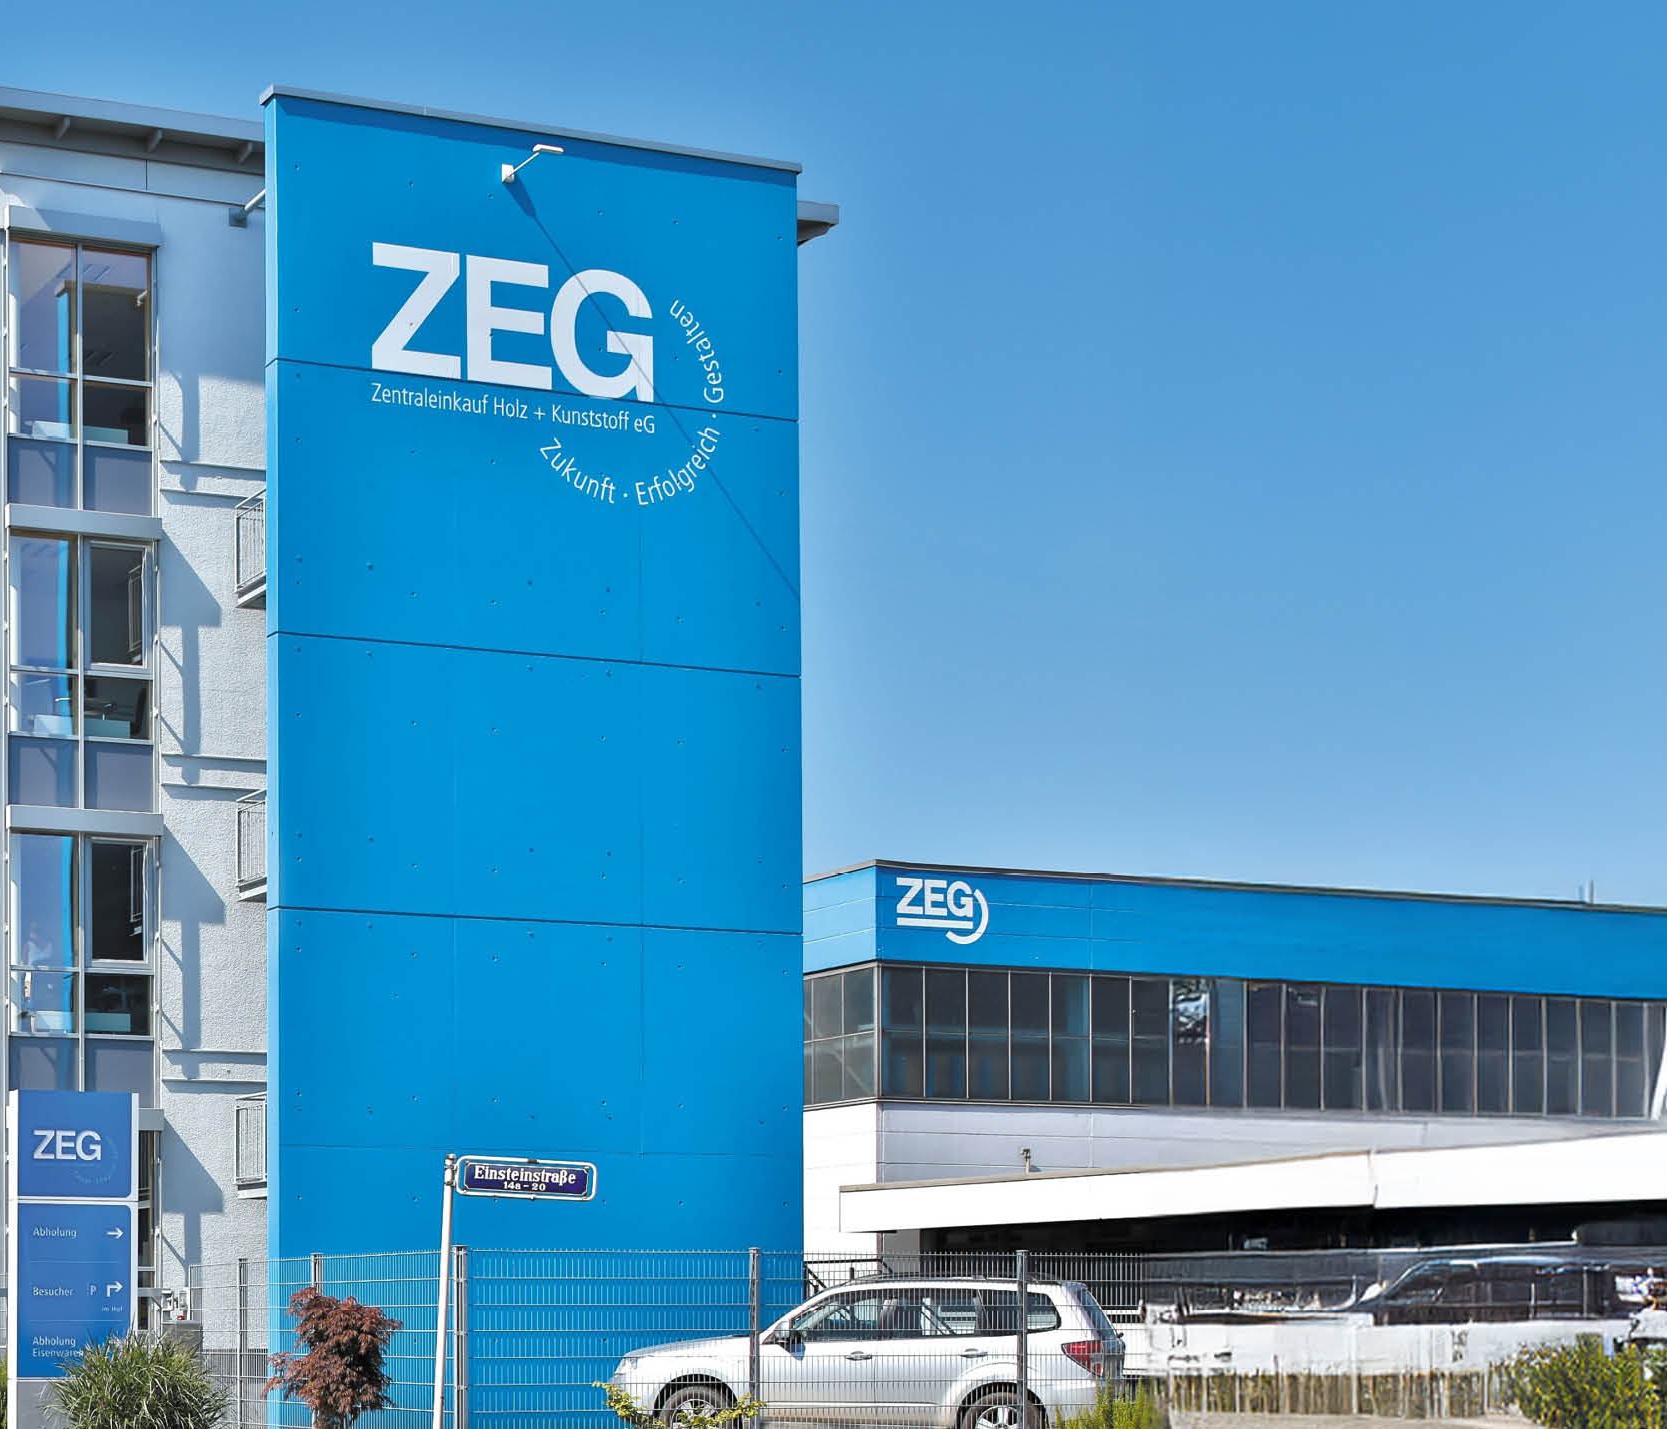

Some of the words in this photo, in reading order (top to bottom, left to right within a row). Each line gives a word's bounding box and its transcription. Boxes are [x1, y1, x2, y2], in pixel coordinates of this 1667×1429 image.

[371, 241, 655, 403] ZEG
[668, 299, 725, 404] Gestalten
[371, 382, 489, 415] Zentraleinkauf
[493, 397, 528, 420] Holz
[533, 407, 546, 420] +
[552, 404, 630, 431] Kunststoff
[633, 415, 655, 434] eG
[539, 437, 616, 504] Zukunft
[635, 427, 720, 506] Erfolgreich
[896, 877, 974, 918] ZEG
[33, 1130, 102, 1161] ZEG
[474, 1165, 577, 1186] Einsteinstraße
[503, 1181, 521, 1190] 14a
[531, 1182, 546, 1191] 20
[33, 1227, 77, 1239] Abholung
[33, 1286, 74, 1297] Besucher
[90, 1285, 97, 1296] P
[32, 1336, 76, 1347] Abholung
